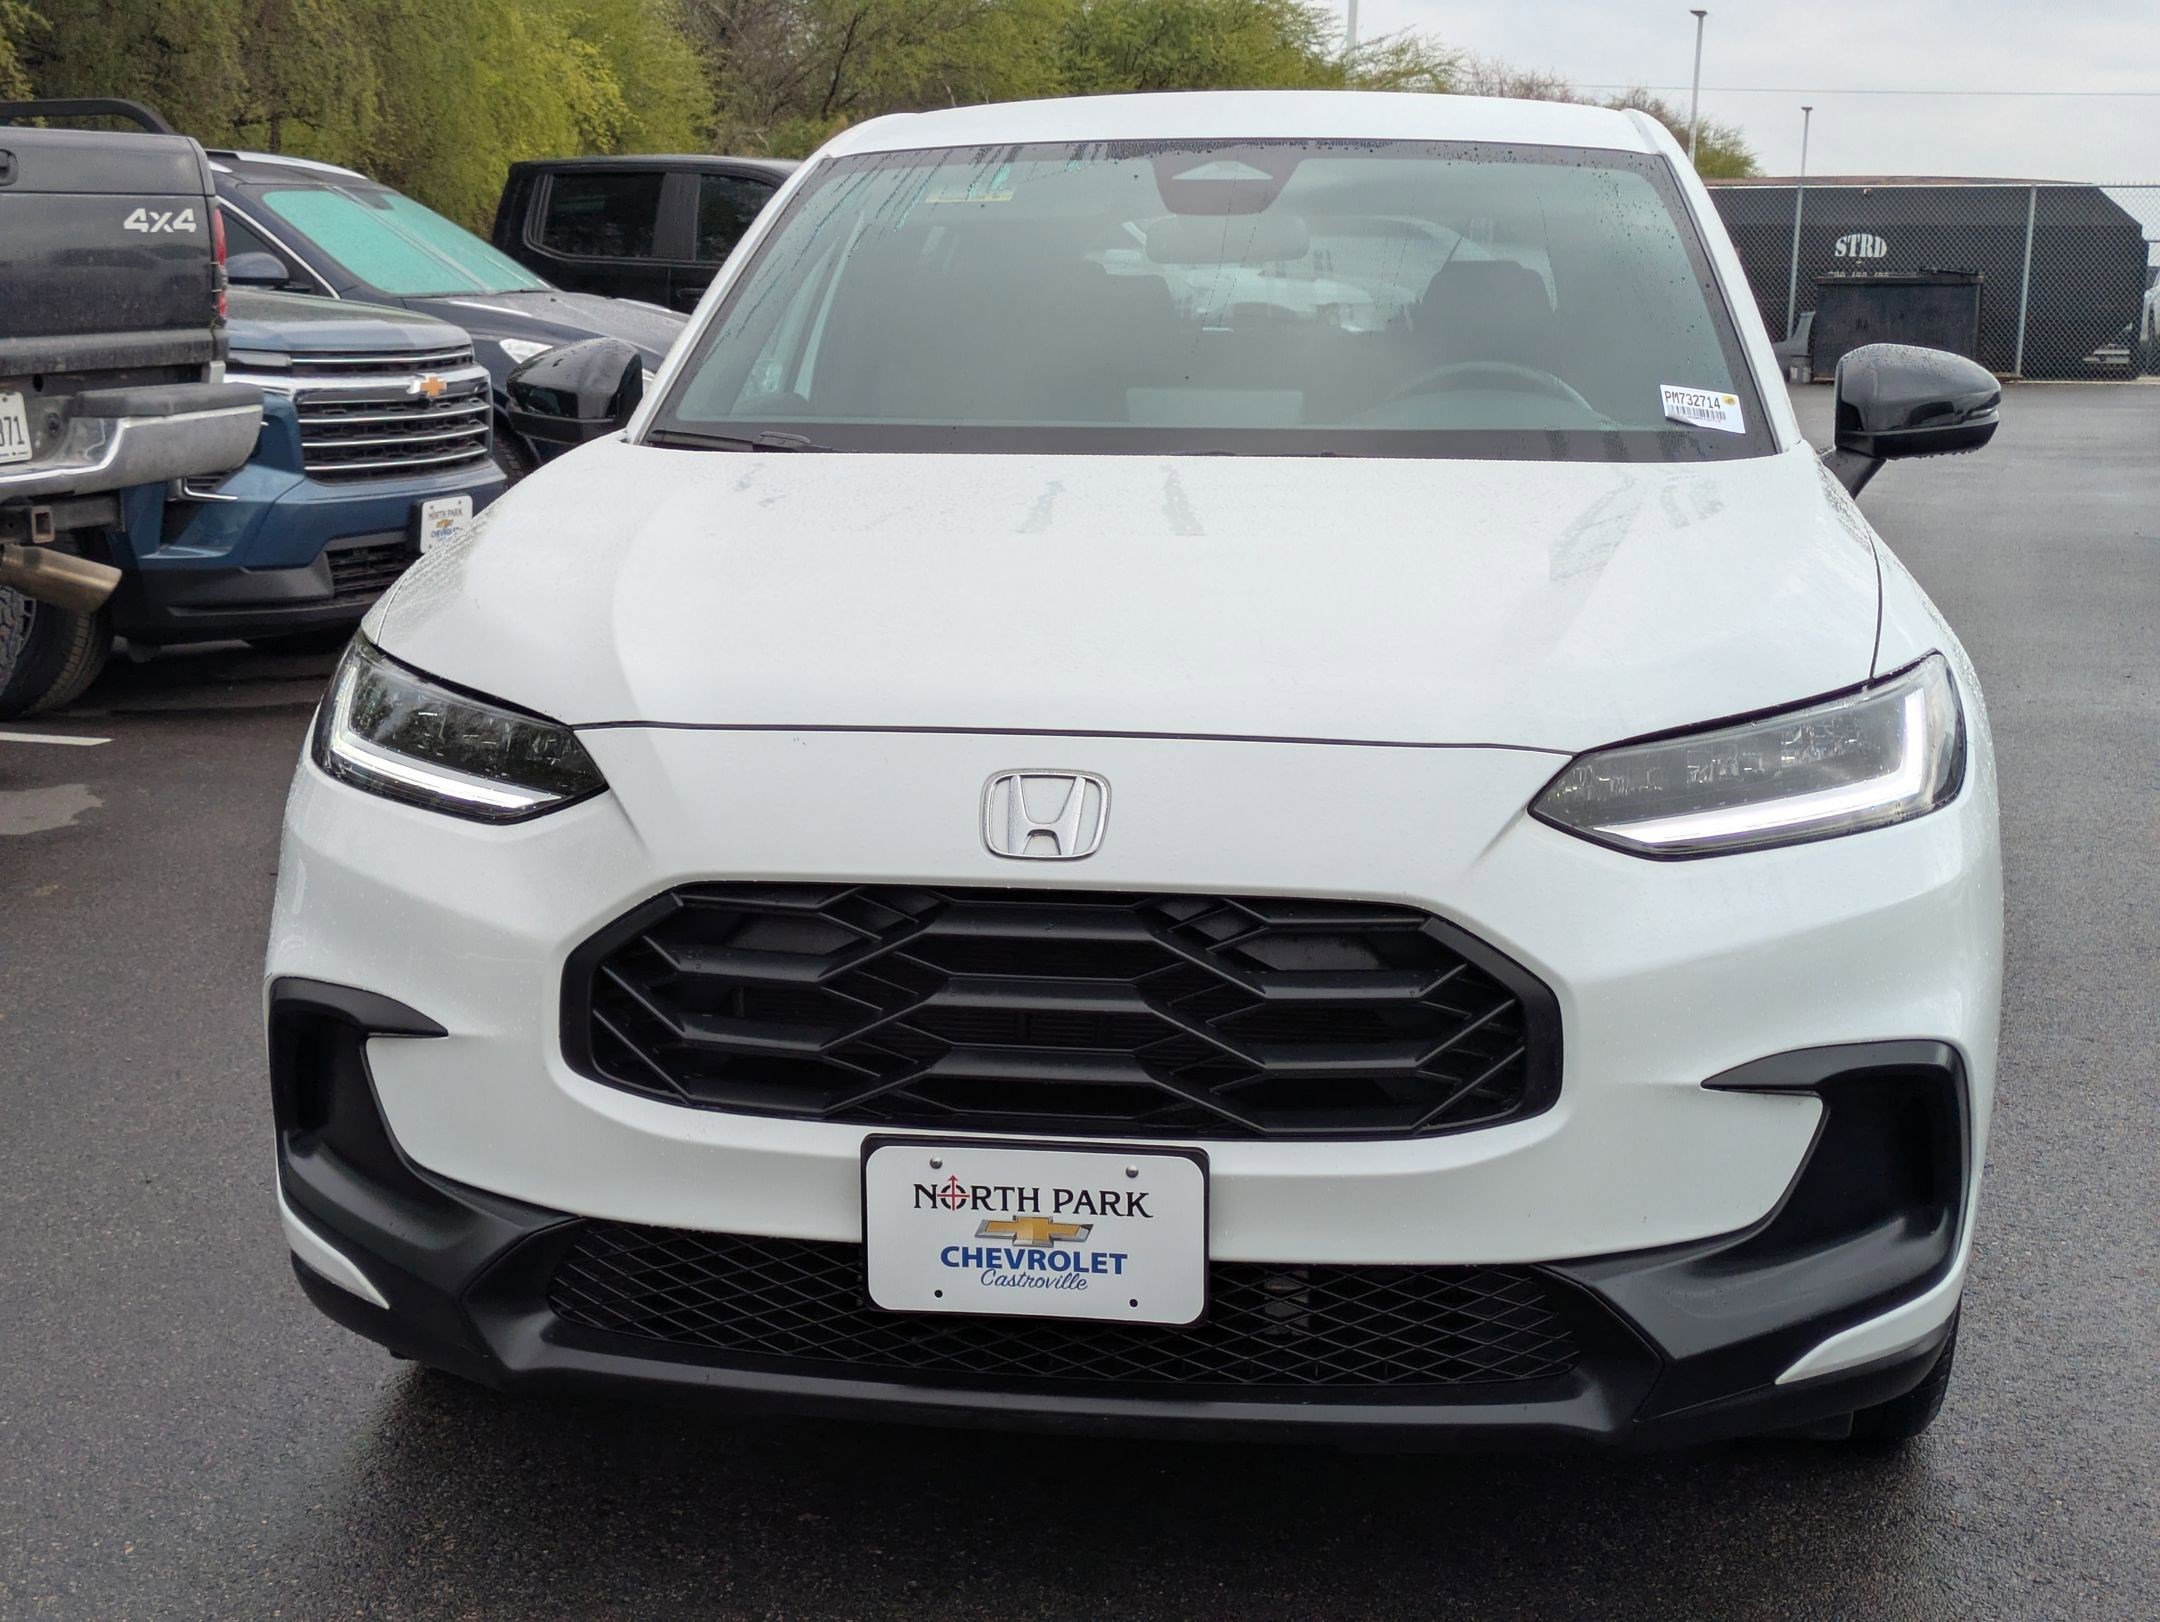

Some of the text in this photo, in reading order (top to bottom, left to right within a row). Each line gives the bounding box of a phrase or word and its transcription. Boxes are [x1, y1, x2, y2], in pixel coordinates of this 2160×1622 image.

[1834, 233, 1888, 258] STRD
[1664, 390, 1721, 409] PM732714
[913, 1183, 1154, 1218] NORTH PARK
[940, 1246, 1128, 1275] CHEVROLET
[980, 1269, 1089, 1291] Castroville
